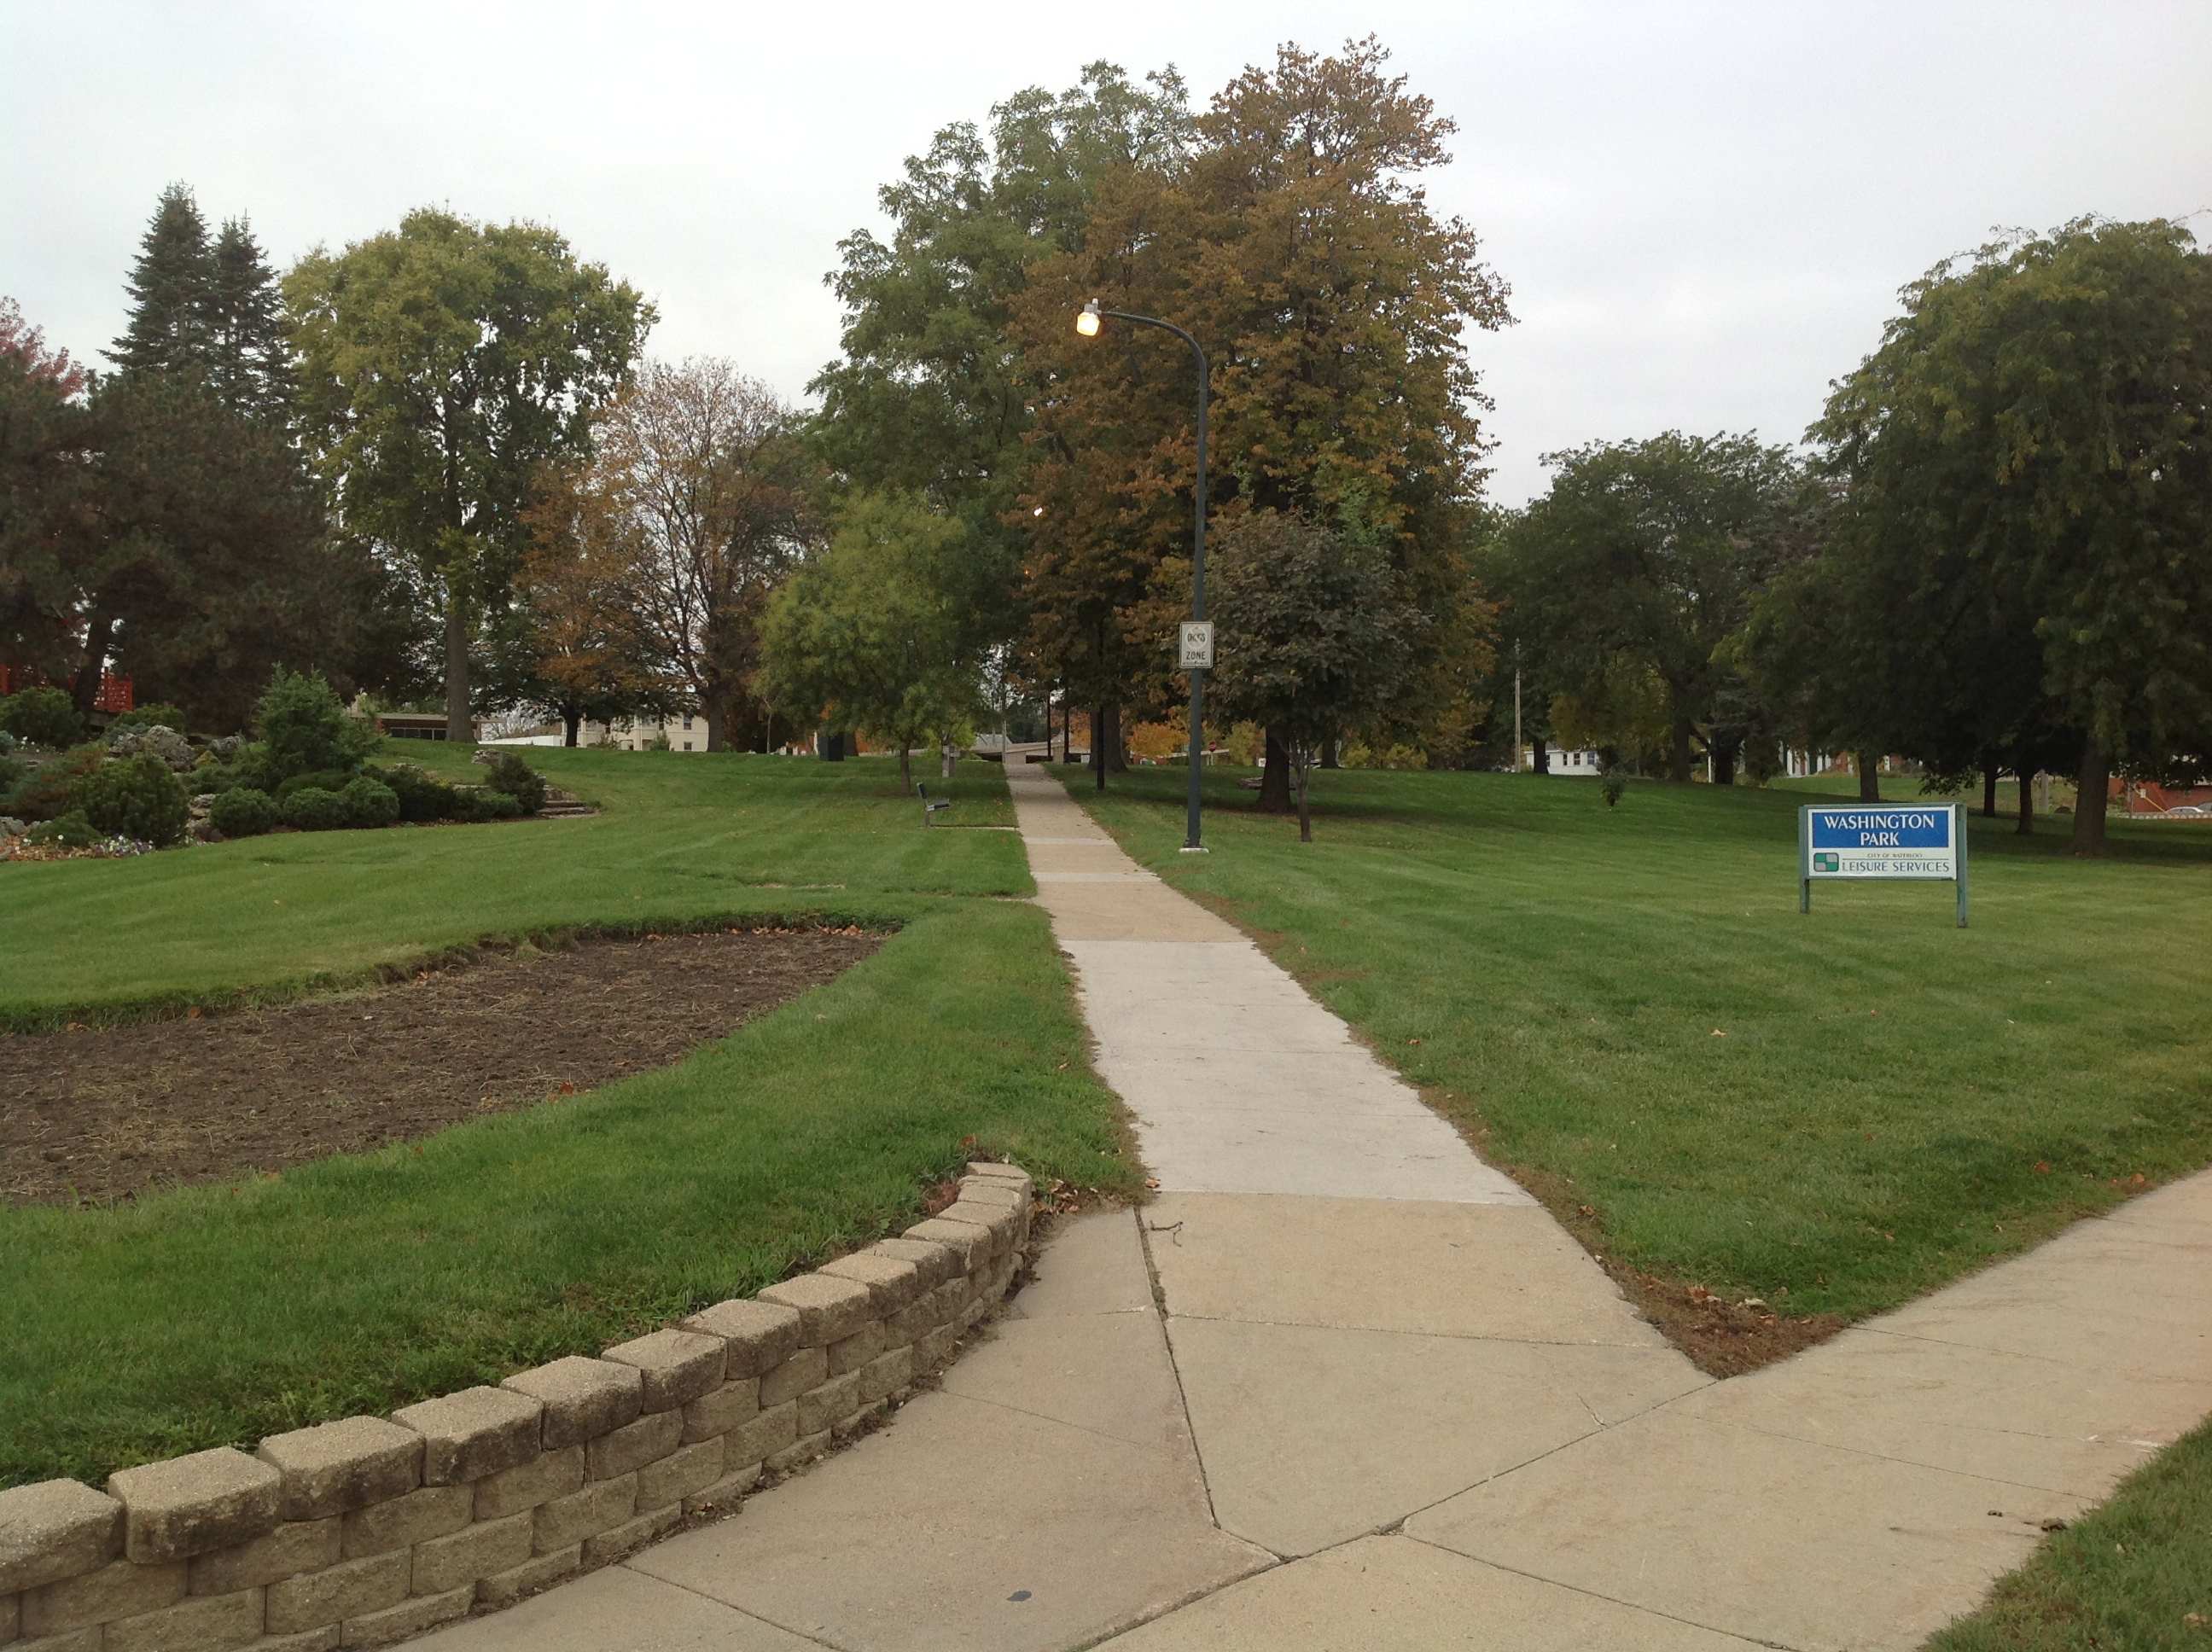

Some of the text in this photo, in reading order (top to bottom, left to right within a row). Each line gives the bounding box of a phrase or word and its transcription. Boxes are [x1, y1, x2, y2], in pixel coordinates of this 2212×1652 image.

[1186, 651, 1206, 660] ZONE
[1824, 814, 1935, 829] WASHINGTON
[1860, 832, 1900, 846] PARK
[1842, 861, 1950, 871] LEISURE SERVICES
